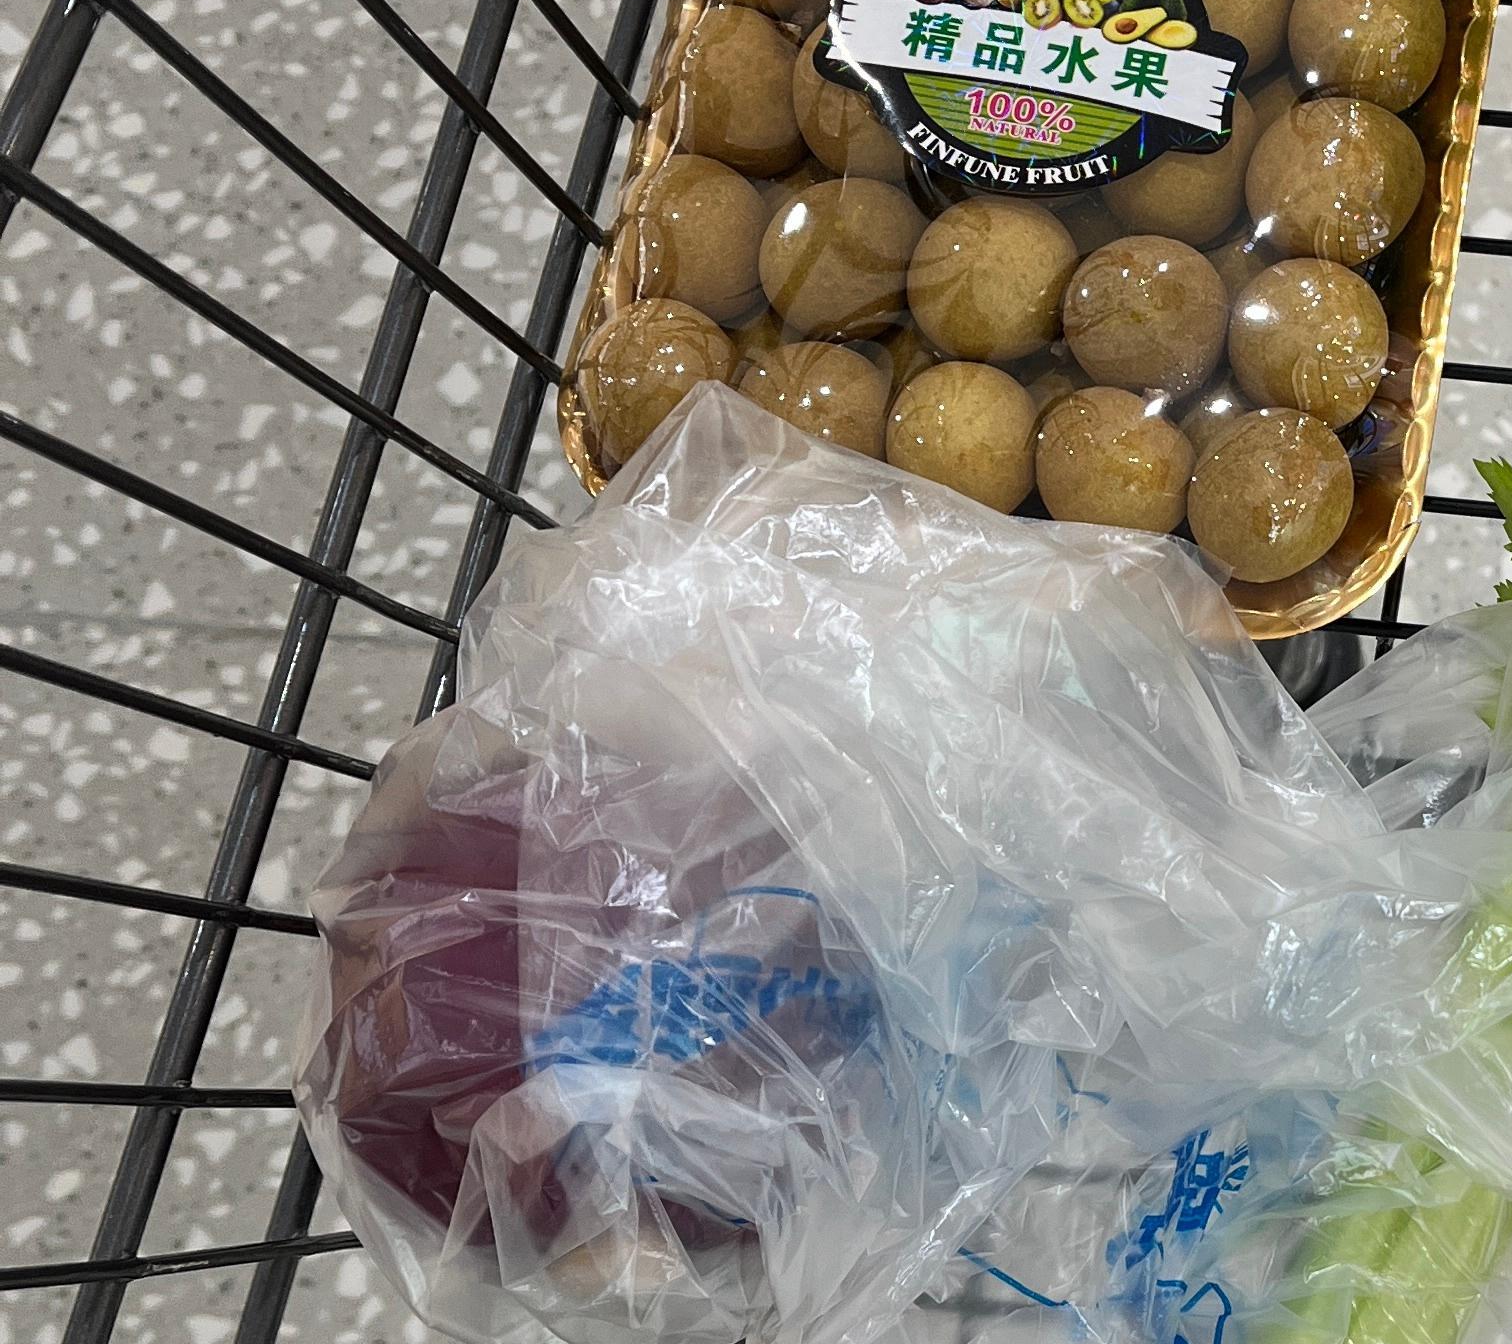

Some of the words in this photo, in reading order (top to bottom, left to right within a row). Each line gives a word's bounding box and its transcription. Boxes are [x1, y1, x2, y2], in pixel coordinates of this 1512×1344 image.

[901, 7, 1169, 100] 精品水果
[965, 87, 1076, 132] 100%
[967, 116, 1062, 145] NATURAL
[907, 121, 1021, 183] FINFUNE
[1025, 154, 1110, 185] FRUIT
